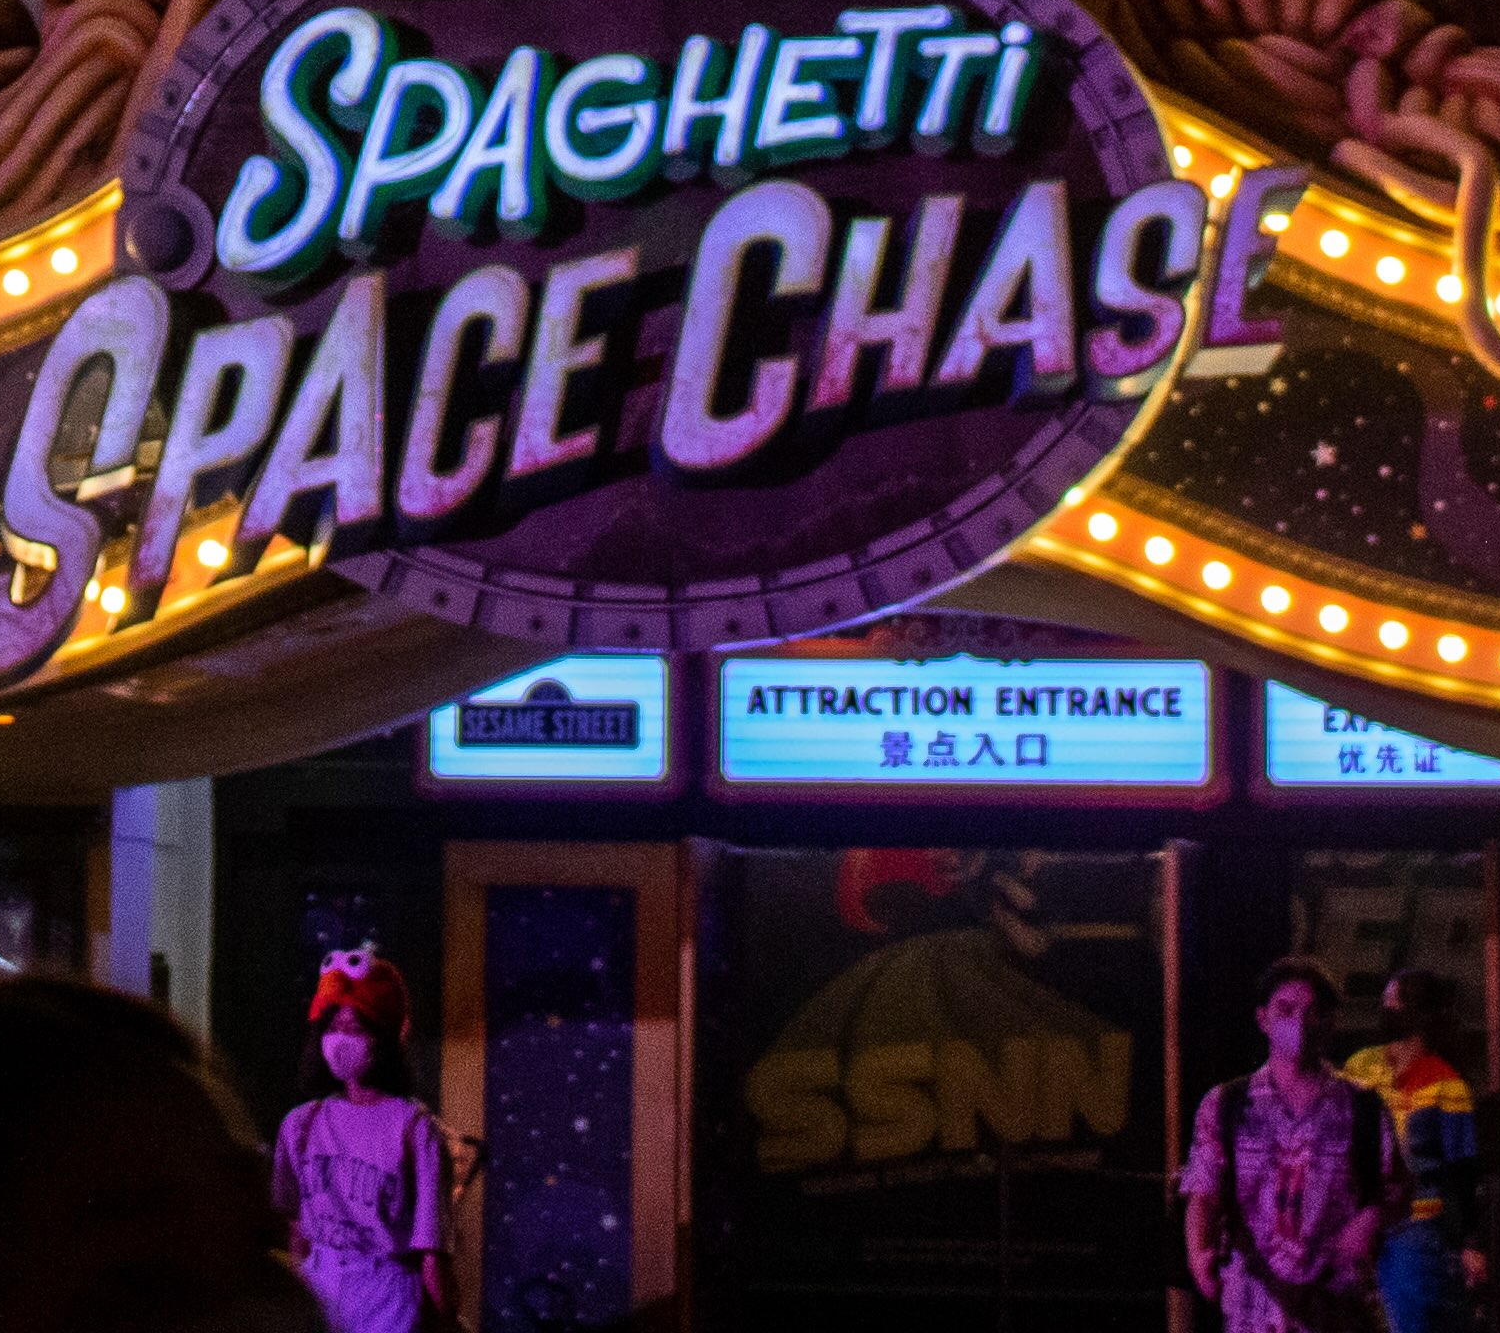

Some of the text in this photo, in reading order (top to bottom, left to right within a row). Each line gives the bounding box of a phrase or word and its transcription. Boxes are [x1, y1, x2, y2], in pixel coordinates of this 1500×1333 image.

[657, 165, 1312, 473] CHASE
[746, 685, 1182, 717] ATTRACTION ENTRANCE
[463, 708, 630, 741] SESAME STREET
[879, 730, 1048, 768] 景点入口
[743, 1027, 1136, 1175] SSNN
